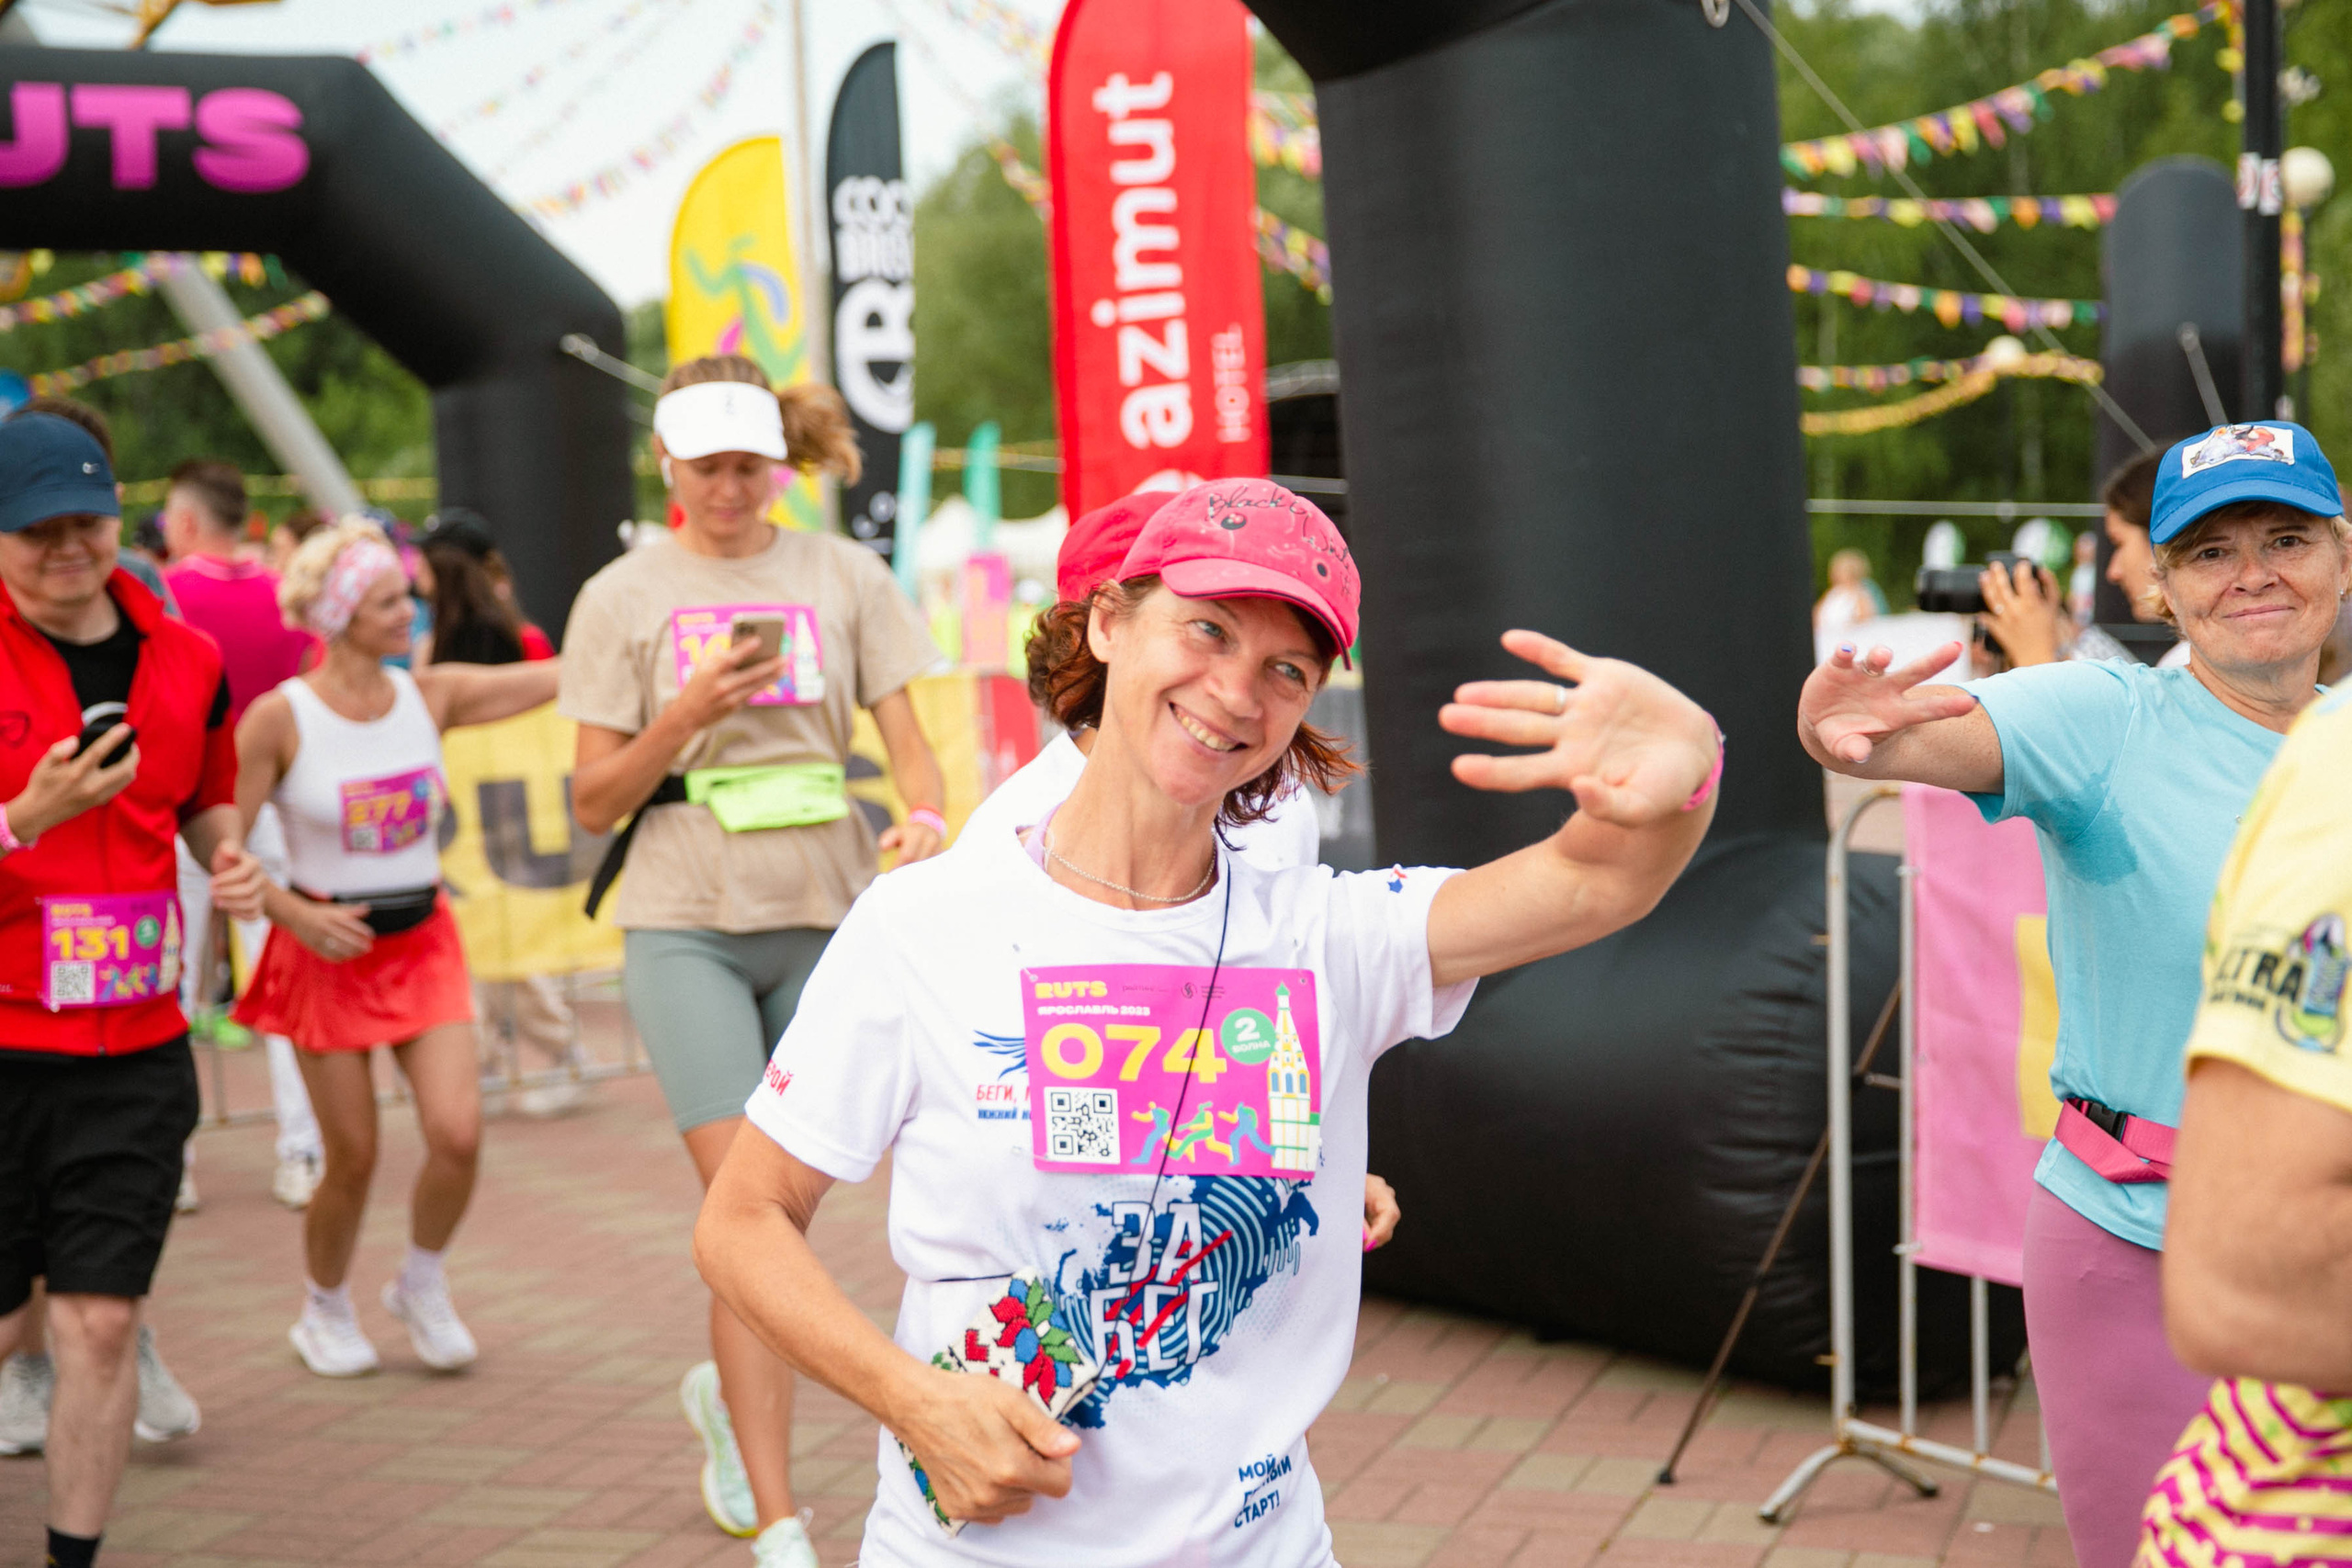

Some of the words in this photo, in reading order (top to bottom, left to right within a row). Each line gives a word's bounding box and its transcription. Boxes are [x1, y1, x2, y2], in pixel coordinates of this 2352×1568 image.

[1091, 70, 1194, 450] azimut
[51, 924, 130, 961] 131
[1035, 980, 1108, 998] RUTS
[1234, 1017, 1261, 1042] 2
[1041, 1022, 1227, 1084] 074
[1238, 1453, 1277, 1483] МОЙ
